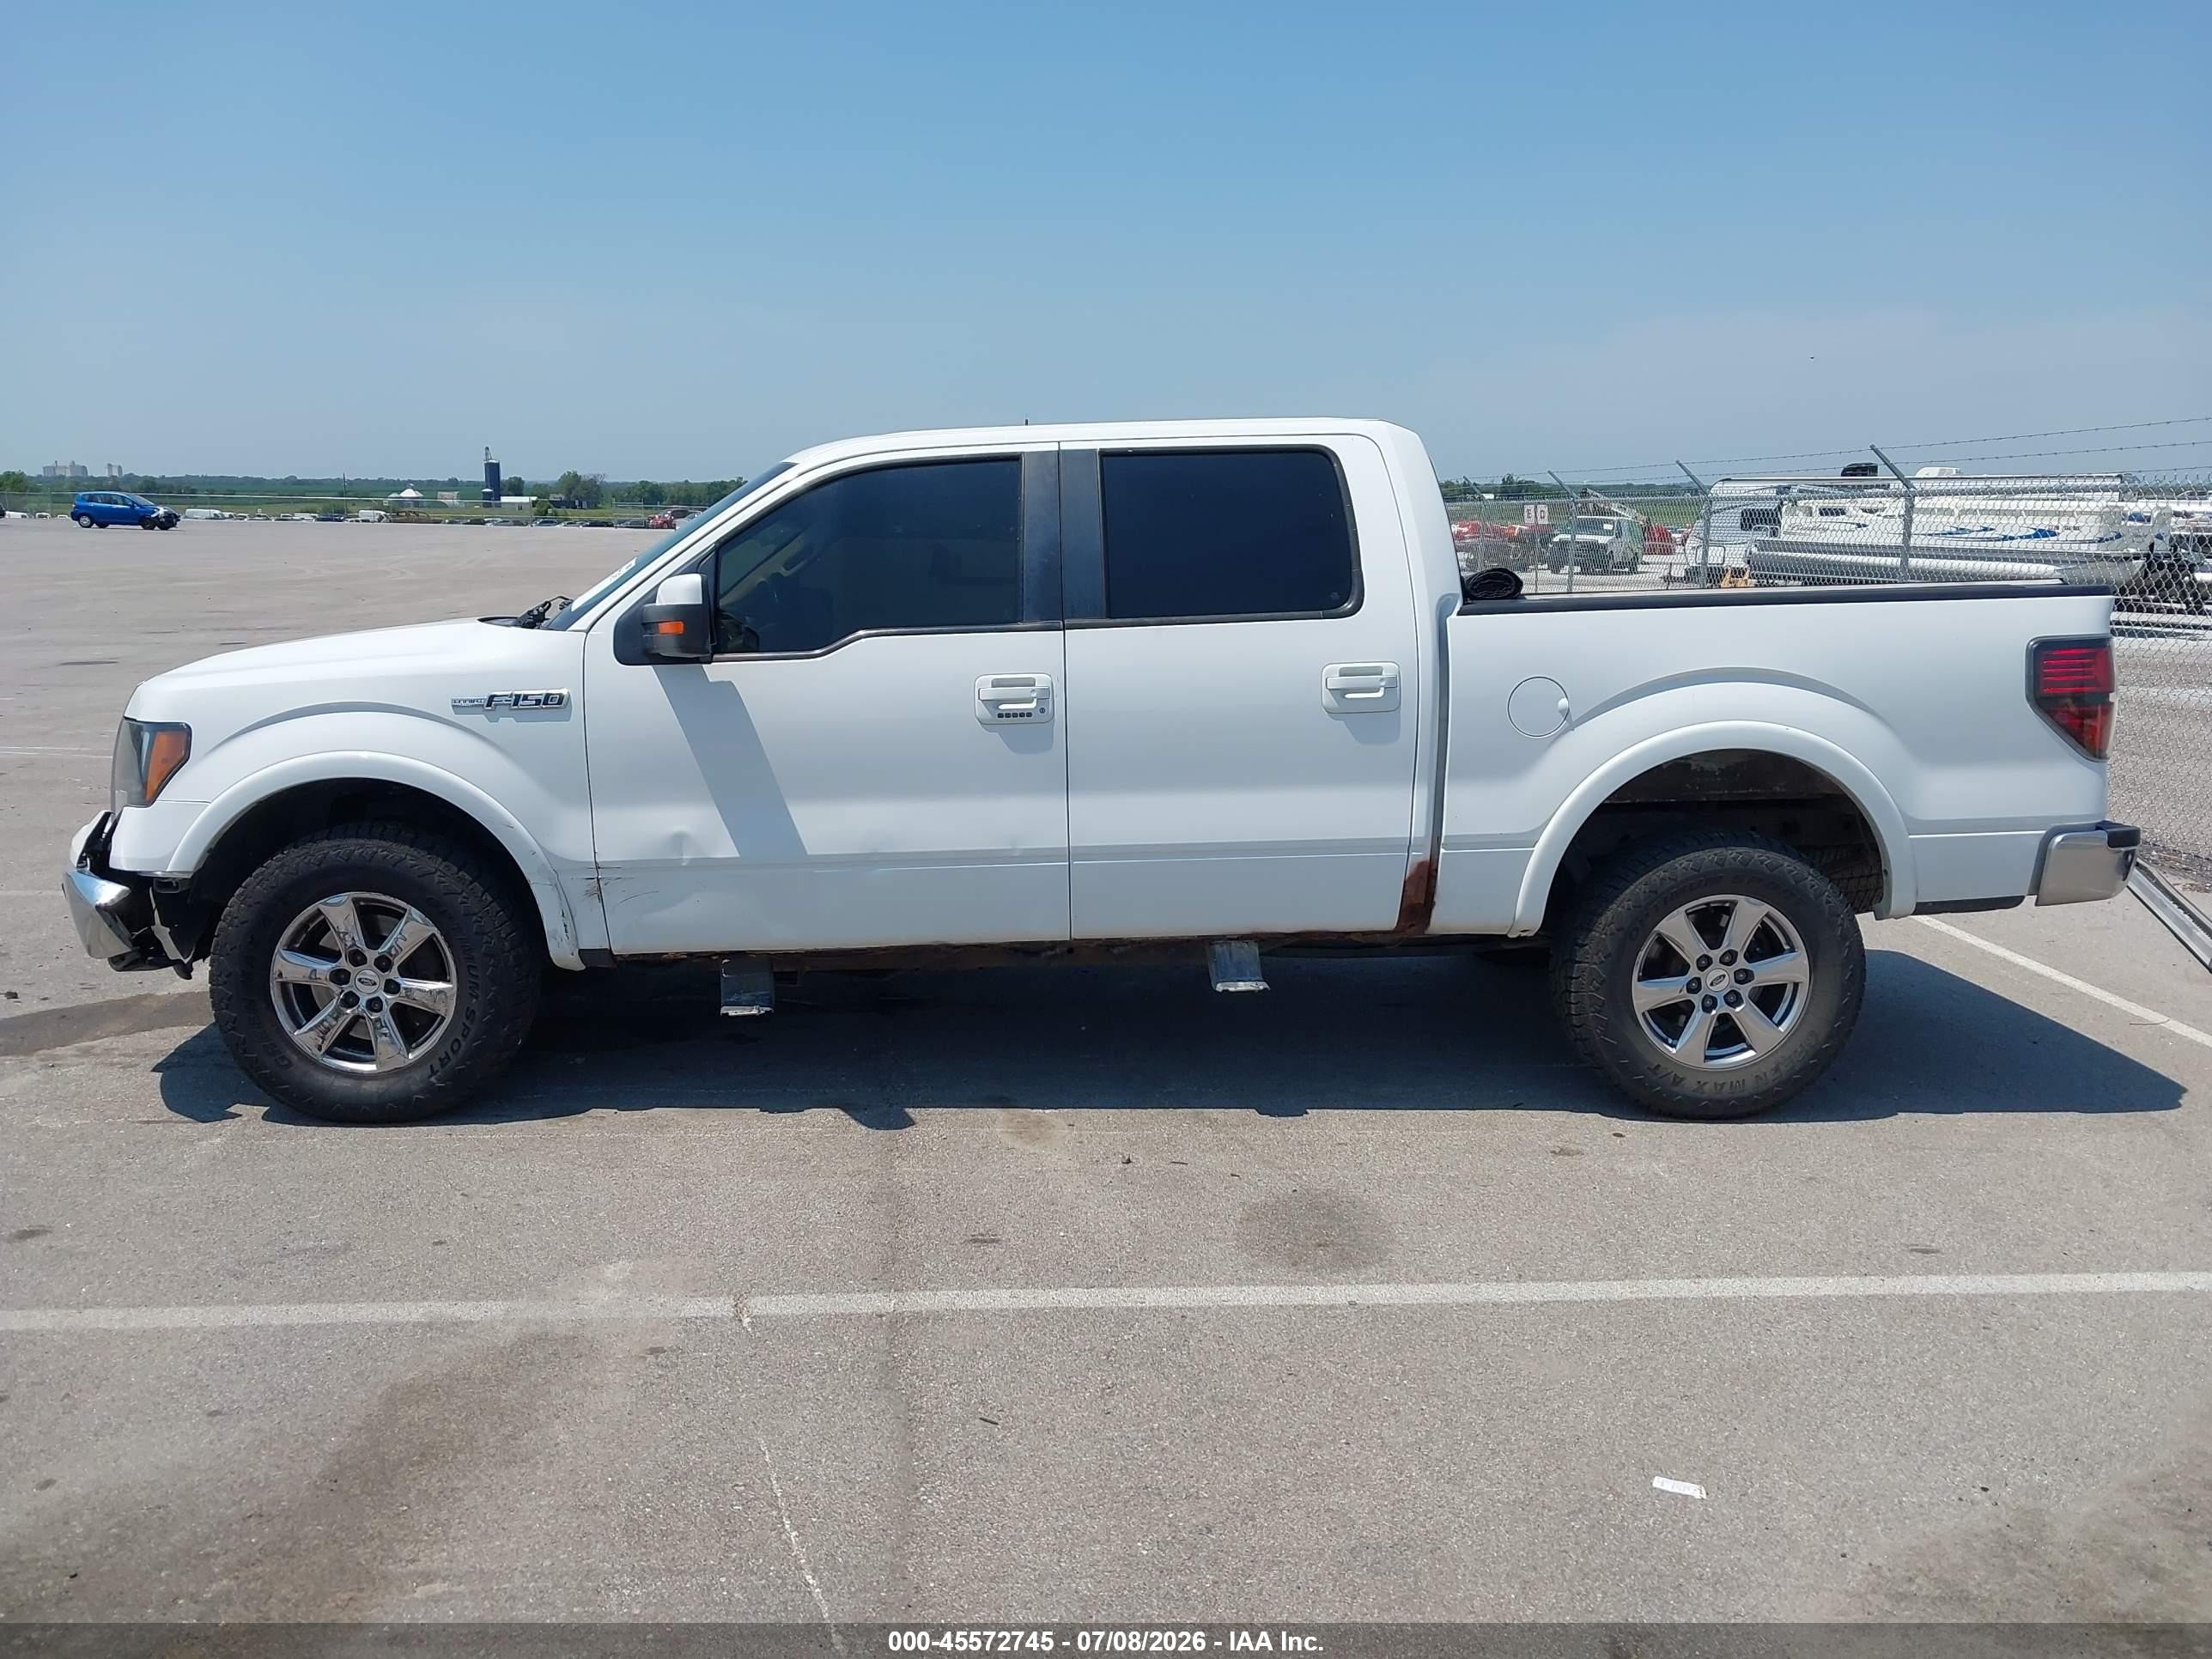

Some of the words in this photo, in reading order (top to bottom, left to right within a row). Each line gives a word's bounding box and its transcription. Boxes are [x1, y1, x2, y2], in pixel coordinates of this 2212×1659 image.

[483, 688, 573, 711] F-150
[430, 1006, 476, 1079] SPORT
[1646, 1063, 1686, 1087] A/T
[1692, 1079, 1746, 1093] MAX
